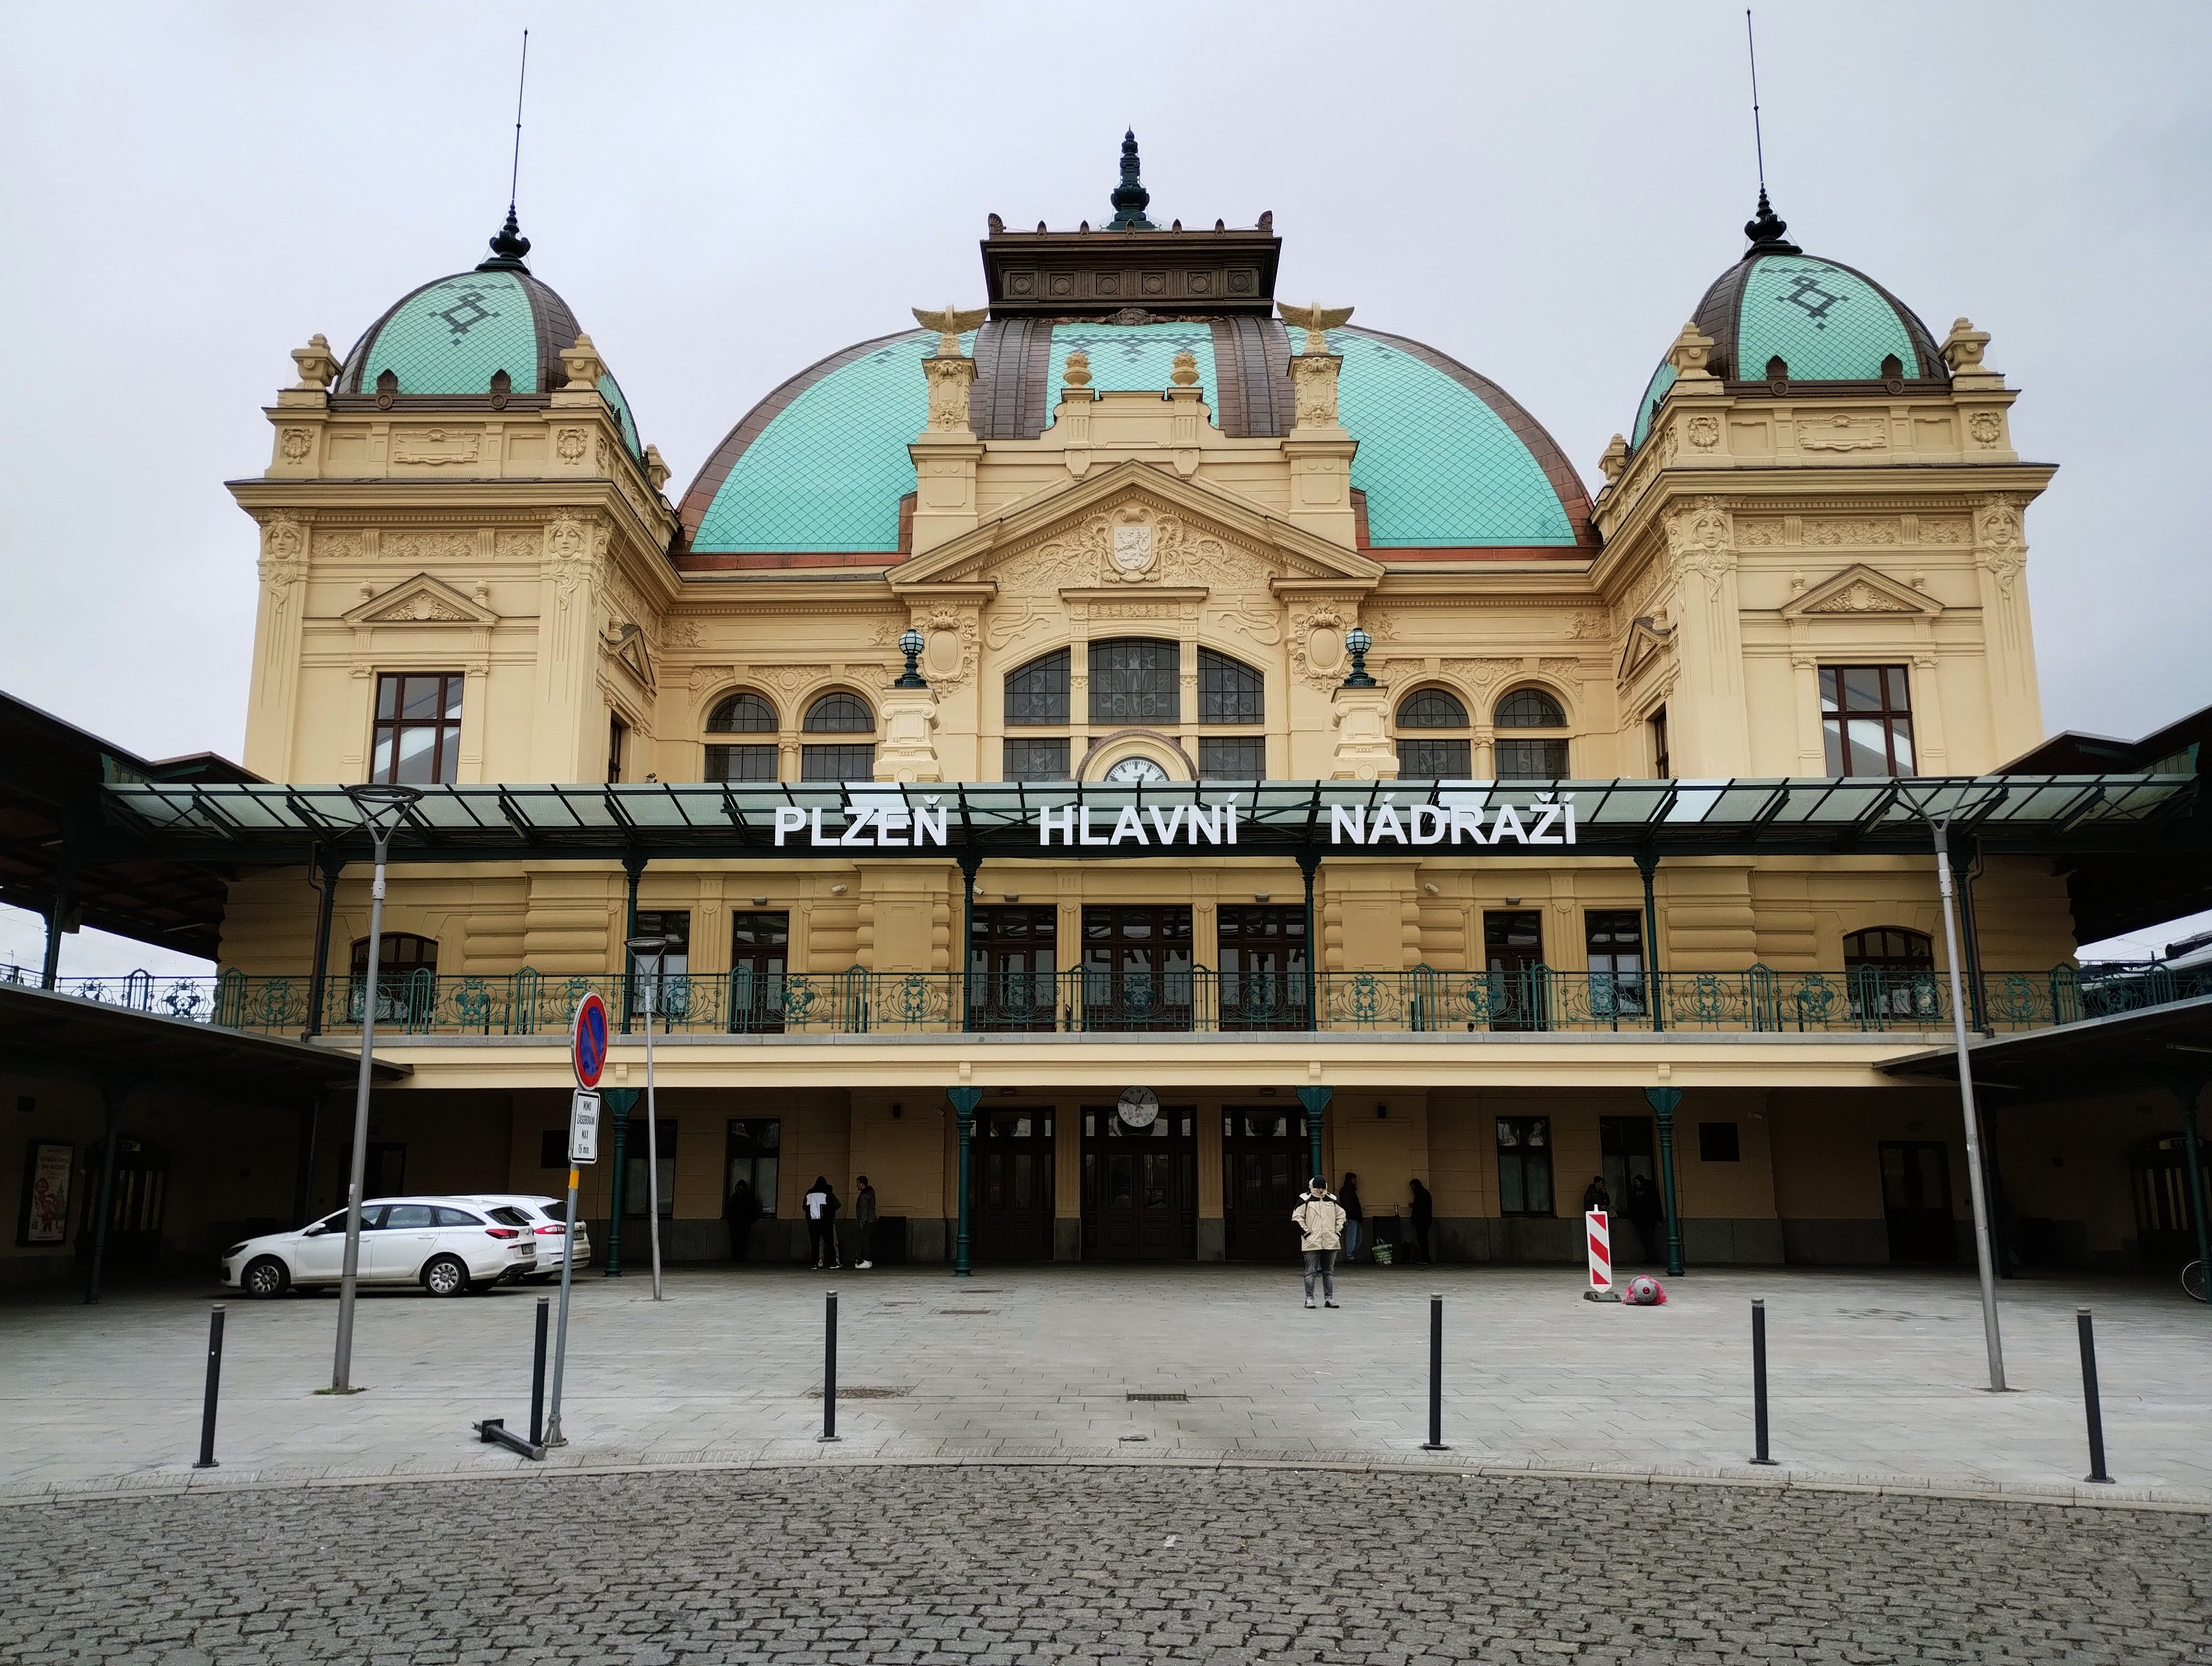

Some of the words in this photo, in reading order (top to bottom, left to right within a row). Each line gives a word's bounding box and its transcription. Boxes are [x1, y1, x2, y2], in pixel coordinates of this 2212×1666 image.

[775, 795, 947, 846] PLZEŇ
[1040, 793, 1240, 845] HLAVNÍ
[1331, 792, 1576, 844] NÁDRAŽÍ
[583, 1100, 592, 1111] MIMO
[578, 1143, 582, 1154] 15
